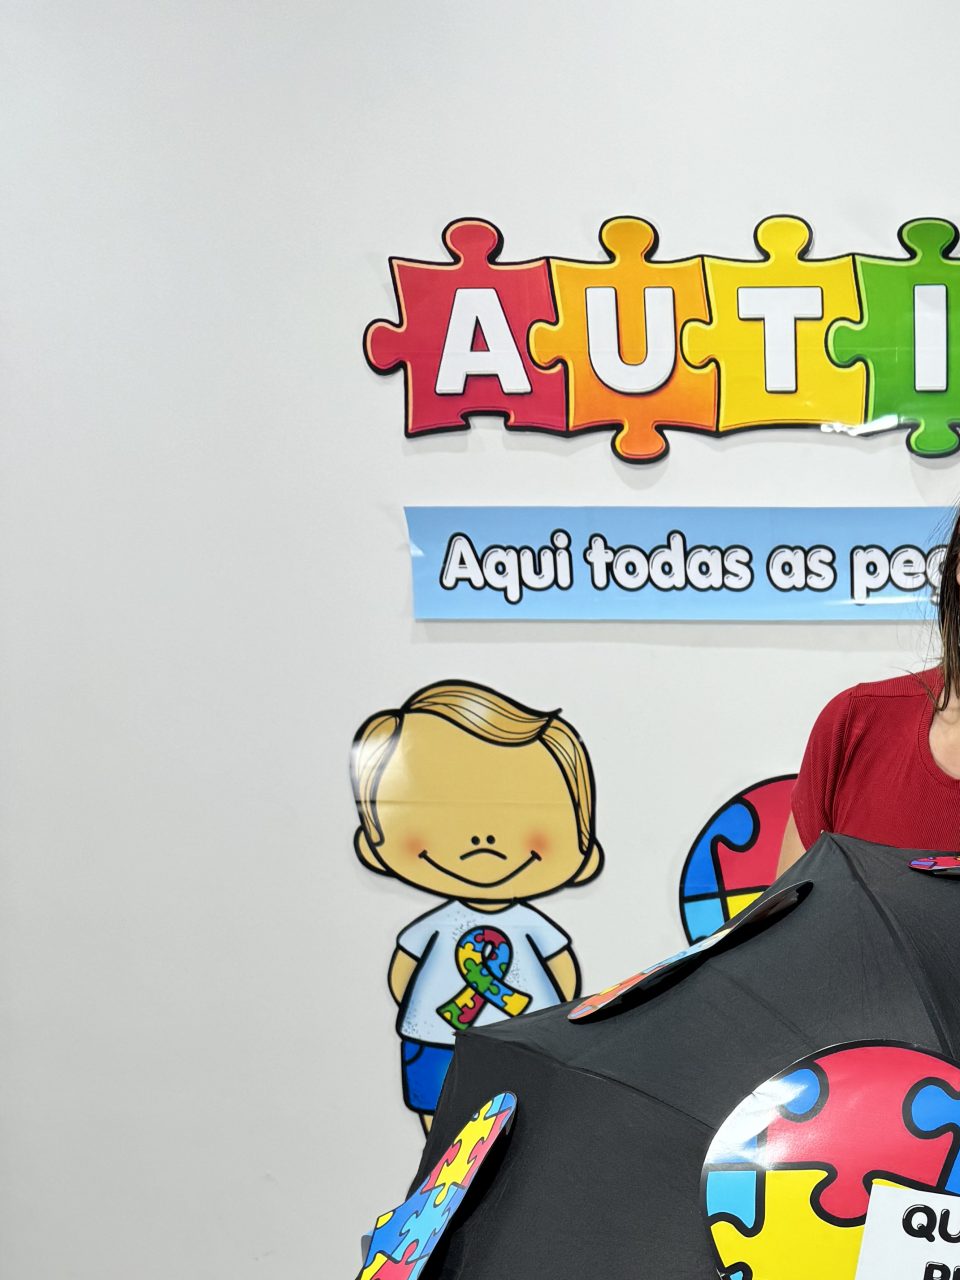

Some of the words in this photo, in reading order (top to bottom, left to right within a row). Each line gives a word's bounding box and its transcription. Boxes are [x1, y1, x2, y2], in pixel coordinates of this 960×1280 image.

[439, 528, 574, 605] Aqui
[586, 528, 753, 592] todas
[766, 544, 836, 592] as
